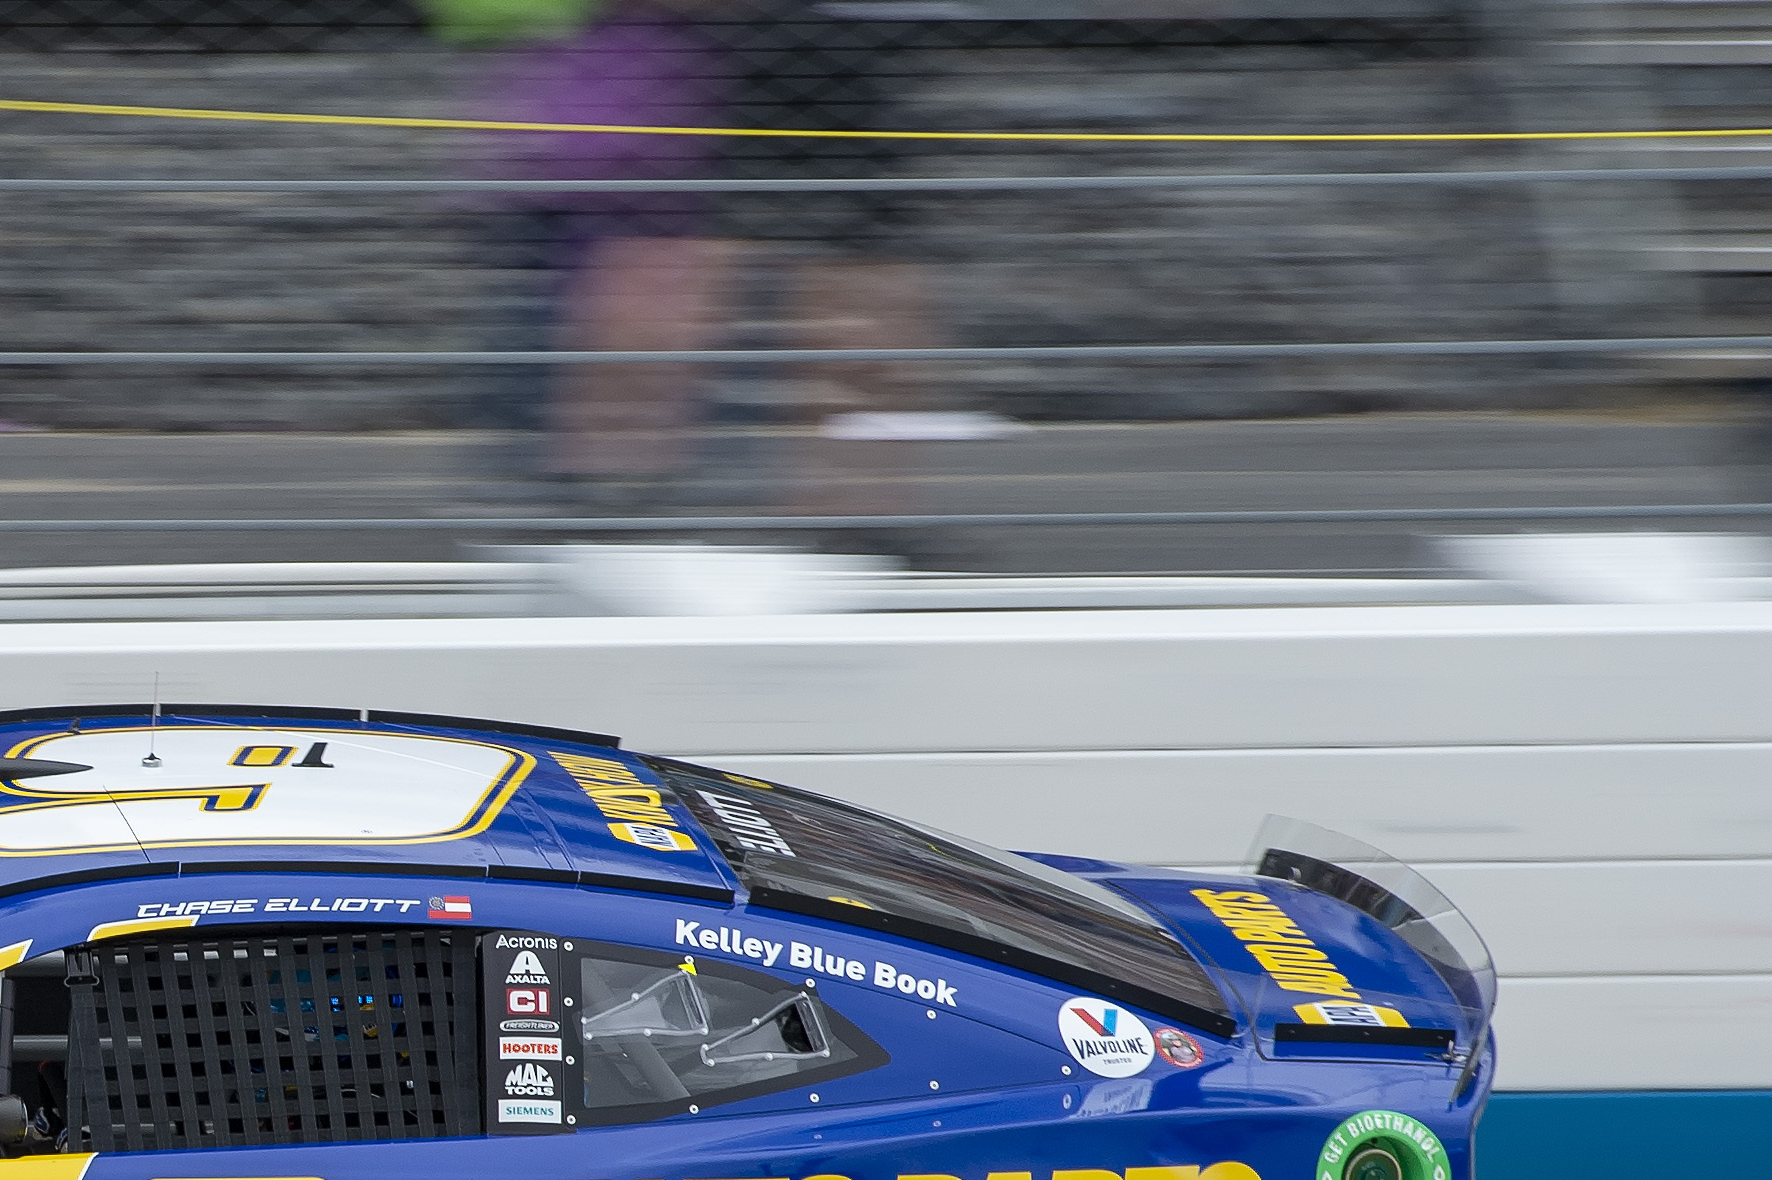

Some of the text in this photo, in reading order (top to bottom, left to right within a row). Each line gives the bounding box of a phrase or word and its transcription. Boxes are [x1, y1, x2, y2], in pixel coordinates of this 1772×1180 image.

[137, 898, 420, 918] CHASE ELLIOTT
[1189, 889, 1315, 945] PARTS
[496, 935, 557, 949] Acronis
[675, 919, 958, 1007] Kelley Blue Book
[1246, 943, 1361, 999] AUTO
[505, 975, 551, 984] AXALTA
[502, 1043, 558, 1054] HOOTERS
[1072, 1037, 1148, 1060] VALVOLINE
[505, 1063, 554, 1086] MAC
[505, 1087, 554, 1096] TOOLS
[506, 1106, 554, 1116] SIEMENS
[1324, 1113, 1440, 1164] GET BIOETHANOL
